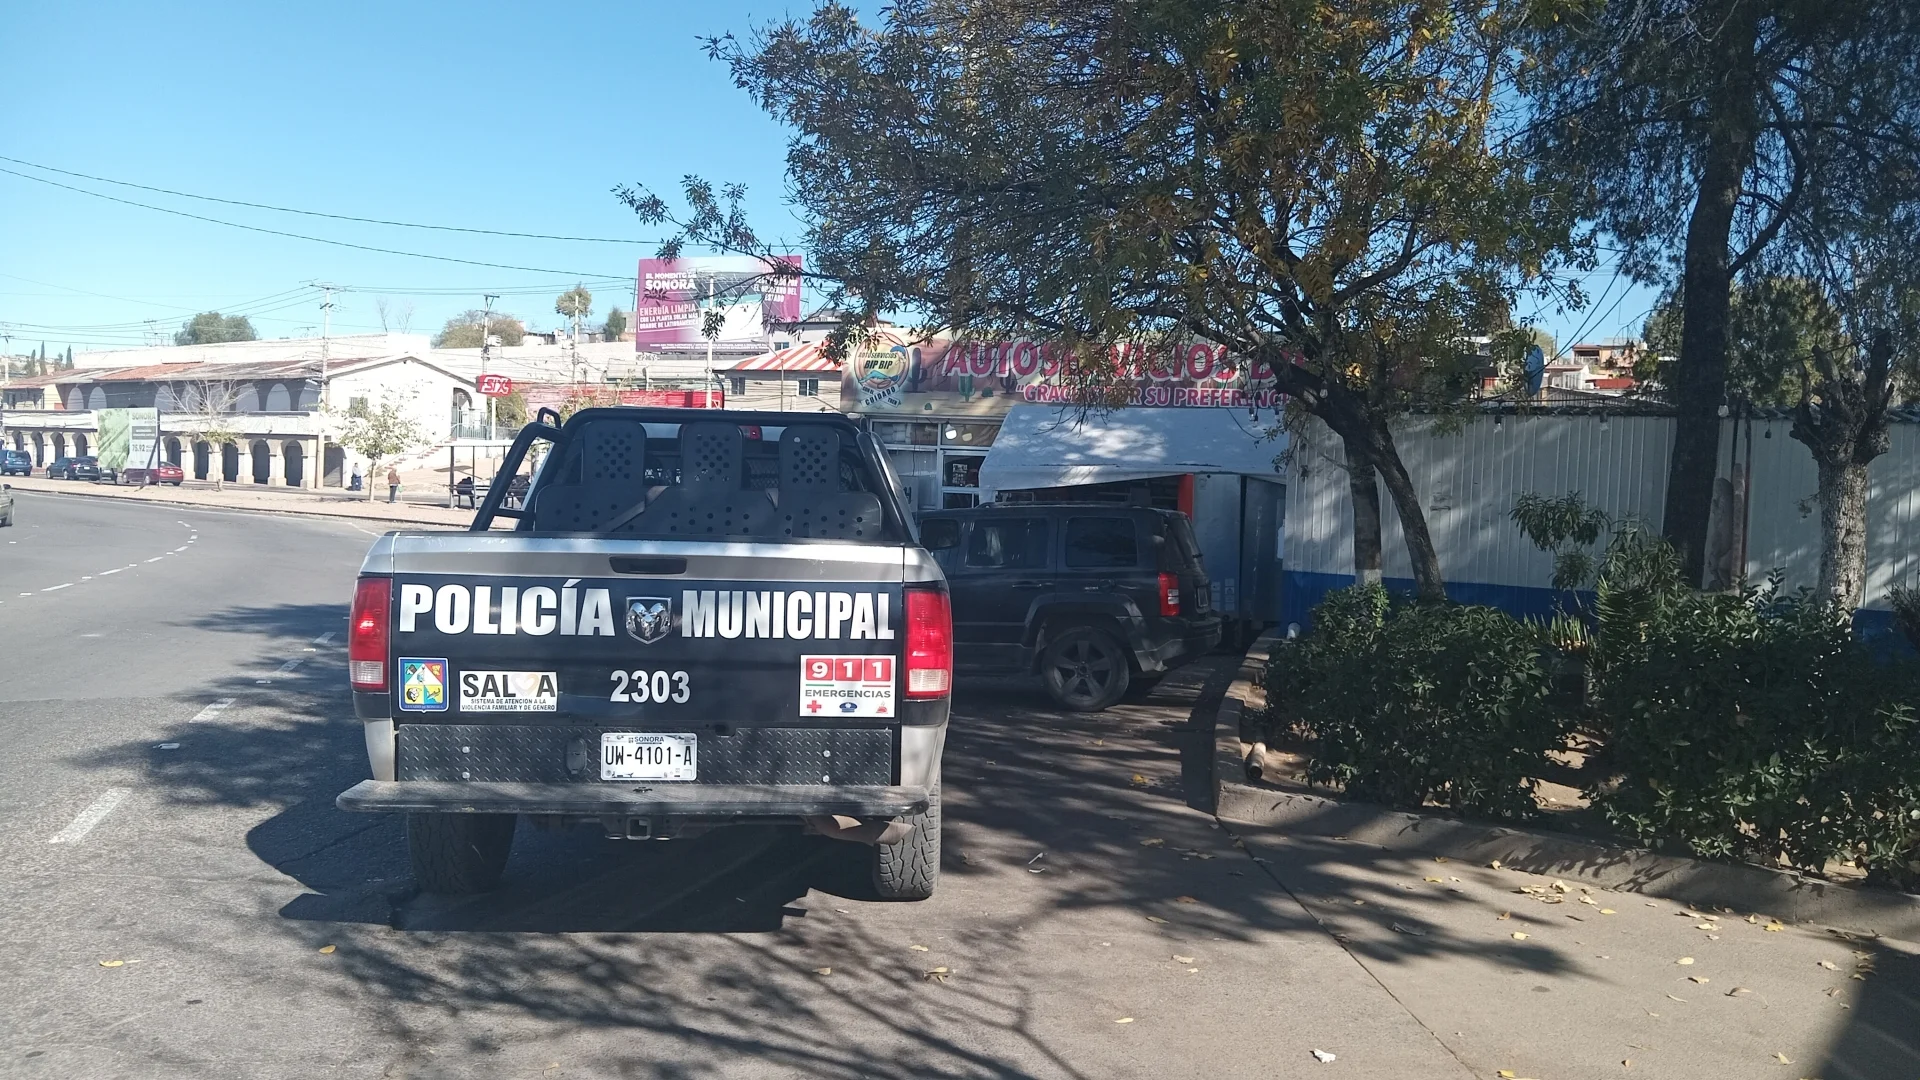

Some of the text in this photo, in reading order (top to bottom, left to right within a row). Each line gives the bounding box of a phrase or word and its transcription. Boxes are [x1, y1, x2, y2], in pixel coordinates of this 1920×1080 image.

[645, 279, 696, 290] SONORA
[640, 303, 696, 316] ENERGÍA LIMPIA
[864, 360, 893, 370] BIP BIP
[865, 386, 896, 405] CUIDADO
[1145, 387, 1169, 406] SU
[399, 578, 895, 640] POLICÍA MUNICIPAL
[610, 670, 691, 704] 2303
[805, 689, 891, 698] EMERGENCIAS
[605, 745, 692, 766] UW-4101-A
